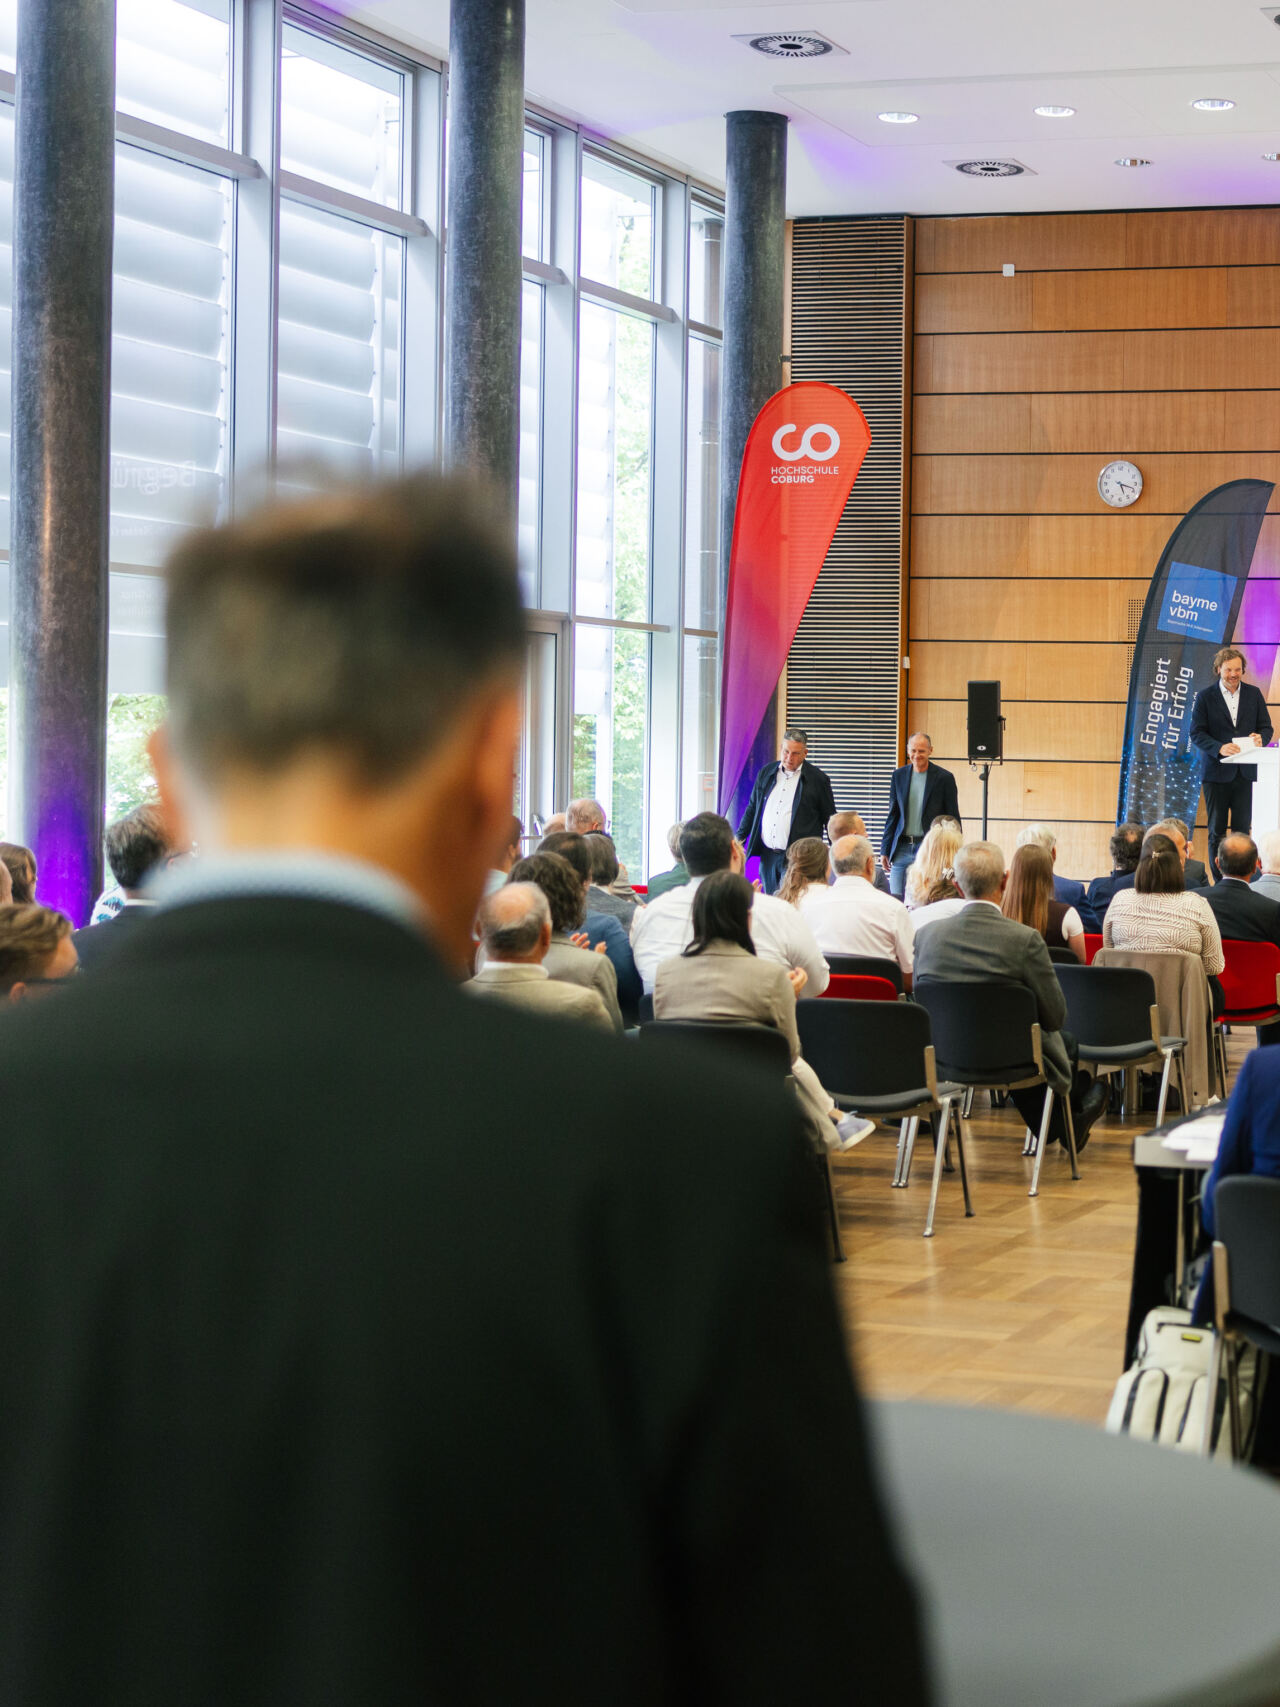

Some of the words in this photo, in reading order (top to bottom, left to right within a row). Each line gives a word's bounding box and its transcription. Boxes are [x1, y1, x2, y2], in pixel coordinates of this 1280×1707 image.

[771, 466, 839, 475] HOCHSCHULE
[771, 475, 815, 484] COBURG
[1171, 589, 1218, 612] bayme
[1169, 605, 1198, 621] vbm
[1140, 657, 1171, 745] Engagiert
[1167, 666, 1194, 720] Erfolg
[1161, 722, 1181, 750] für
